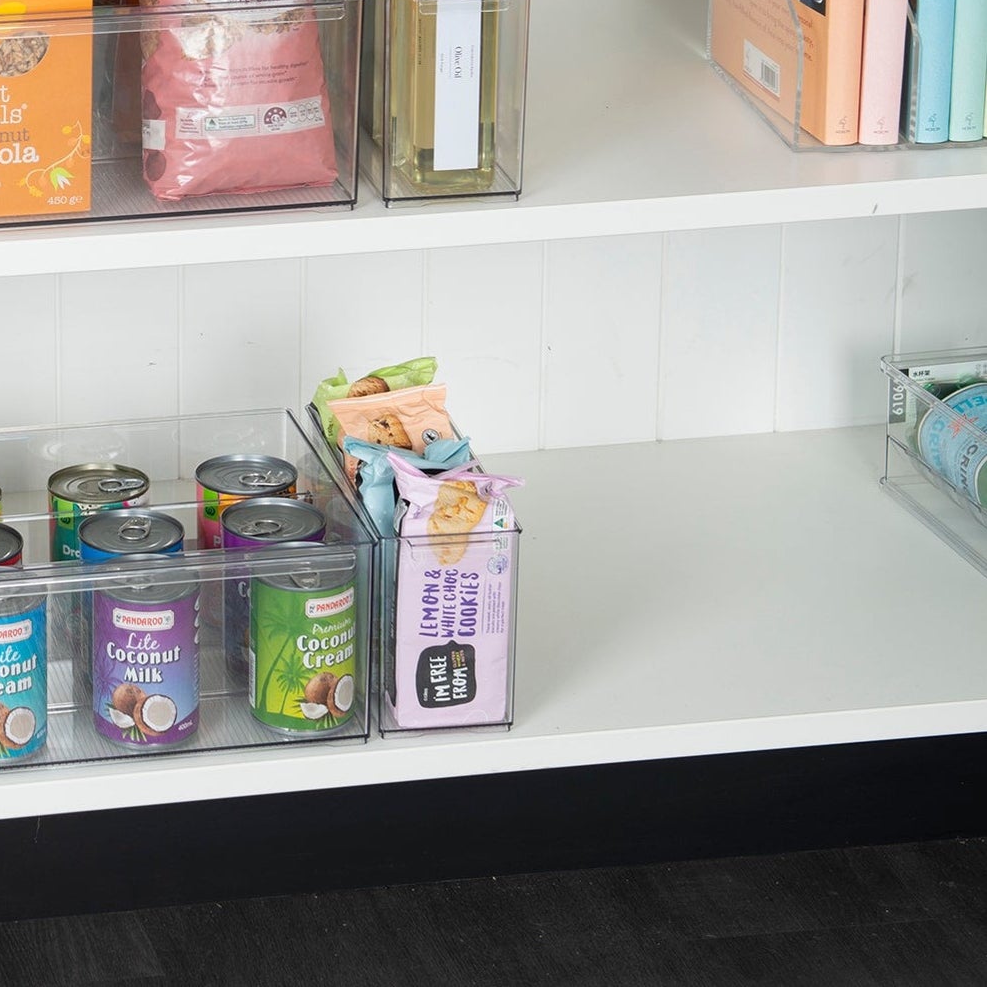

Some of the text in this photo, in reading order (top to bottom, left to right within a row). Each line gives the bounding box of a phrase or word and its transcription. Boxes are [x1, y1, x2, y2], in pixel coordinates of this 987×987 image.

[418, 569, 441, 638] LEMON &
[441, 569, 458, 638] WHITE CHOC
[122, 615, 164, 627] PANDAROO
[106, 641, 182, 664] Coconut
[125, 632, 161, 651] Lite
[302, 645, 354, 669] Cream
[123, 665, 164, 684] Milk
[429, 656, 448, 683] FREE
[451, 667, 468, 699] FROM
